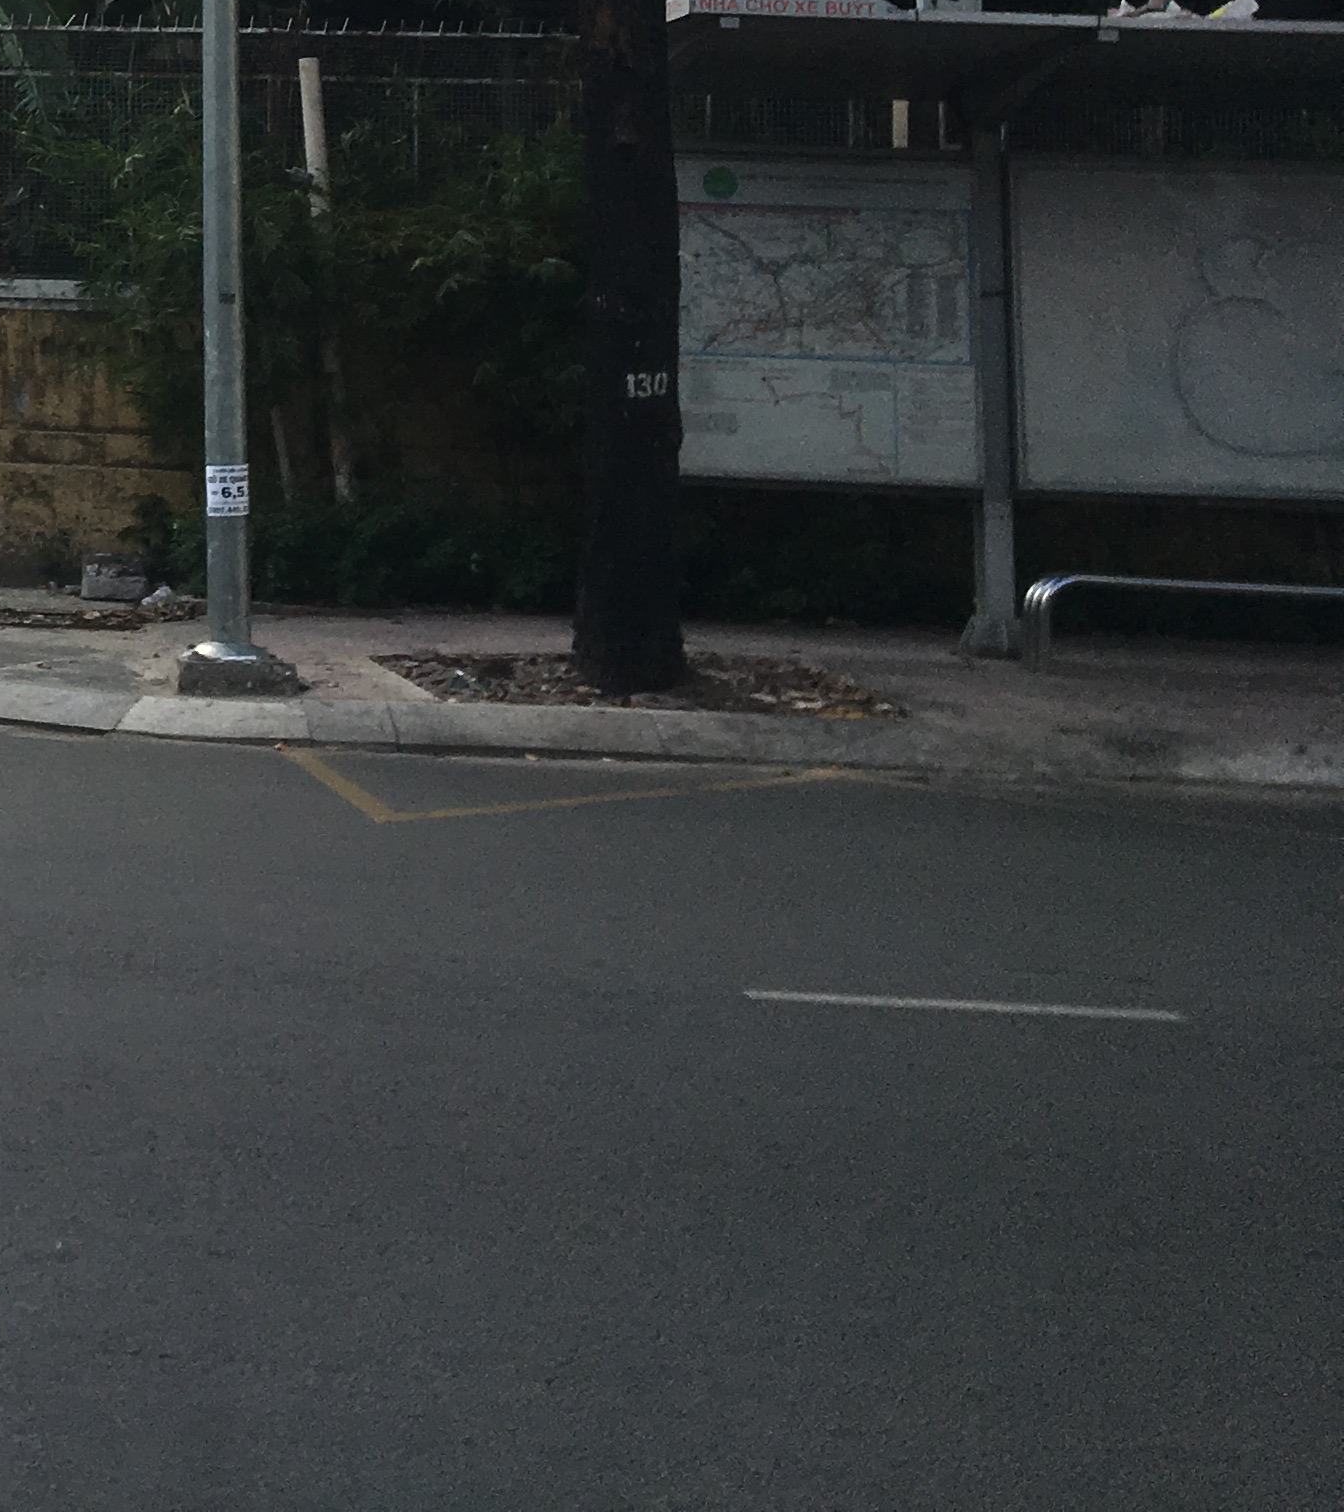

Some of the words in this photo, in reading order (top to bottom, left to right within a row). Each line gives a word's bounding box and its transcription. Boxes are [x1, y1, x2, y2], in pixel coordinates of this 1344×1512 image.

[795, 0, 818, 15] XE
[626, 372, 667, 398] 130
[221, 486, 249, 500] 6,5
